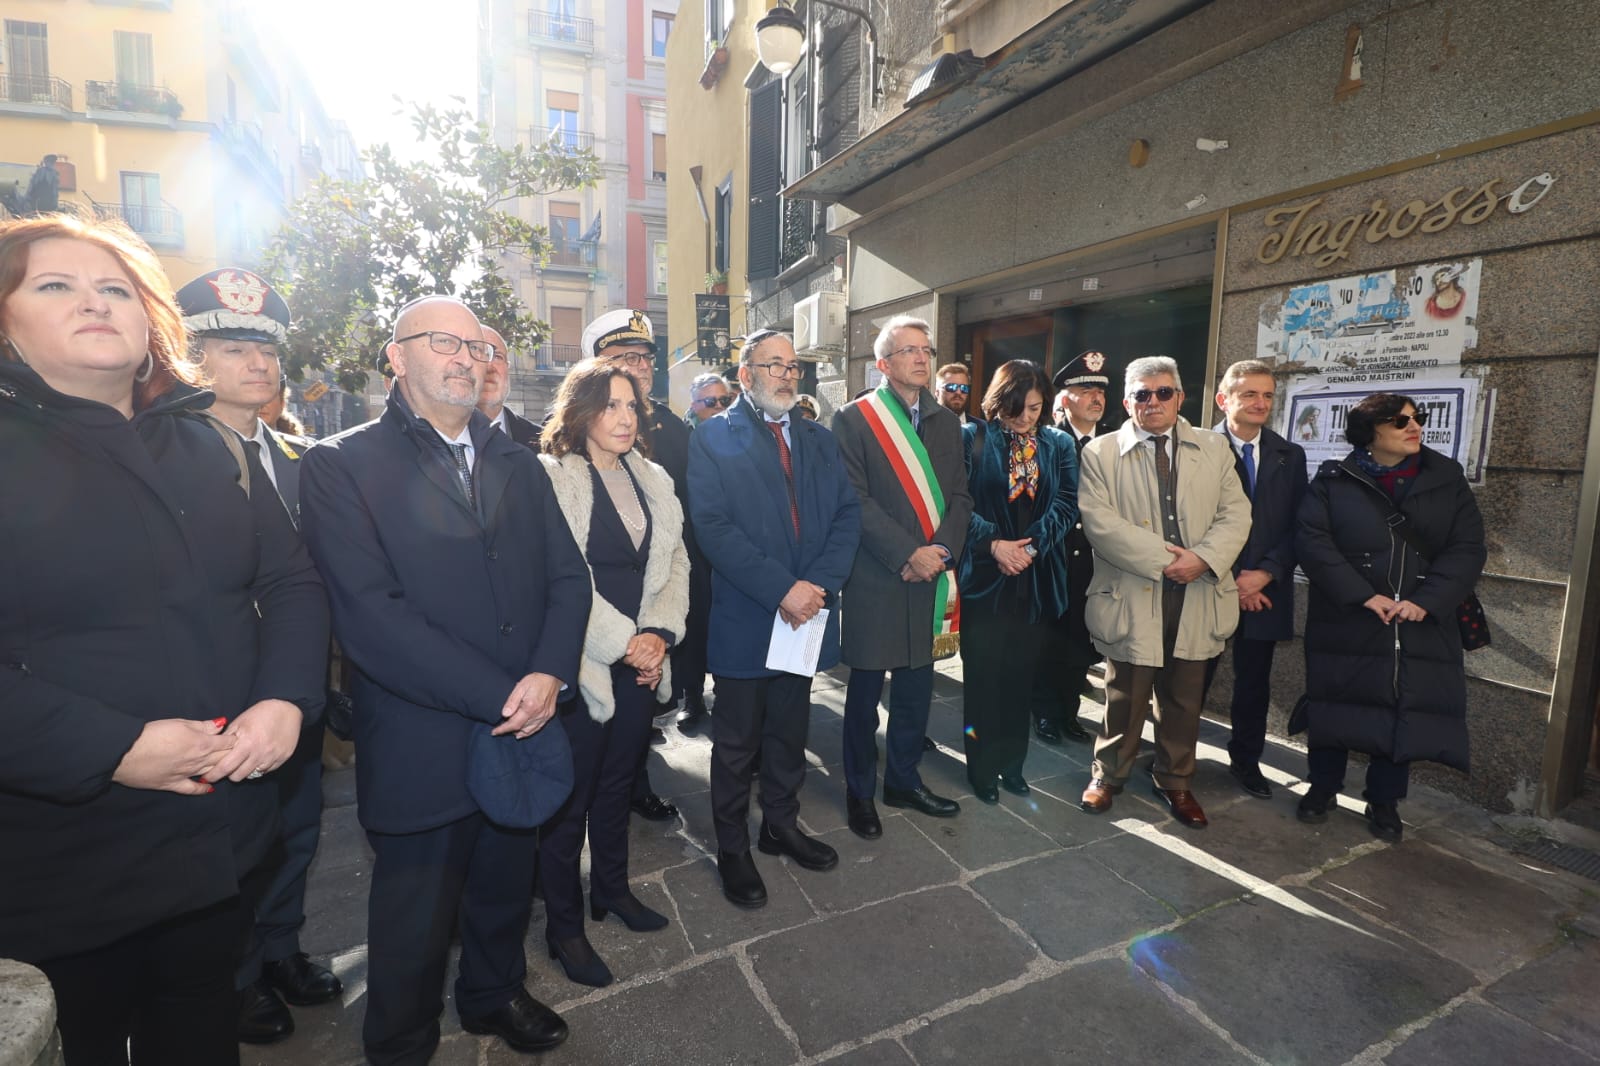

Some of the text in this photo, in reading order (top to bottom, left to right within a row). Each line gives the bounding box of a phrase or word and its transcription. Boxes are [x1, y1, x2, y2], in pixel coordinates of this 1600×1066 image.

[1256, 172, 1558, 268] Ingrosso
[1411, 343, 1430, 352] NAPOLI
[1367, 358, 1439, 370] RINGRAZIAMENTO
[1326, 374, 1367, 384] GENNARO
[1369, 371, 1416, 382] MAISTRINI
